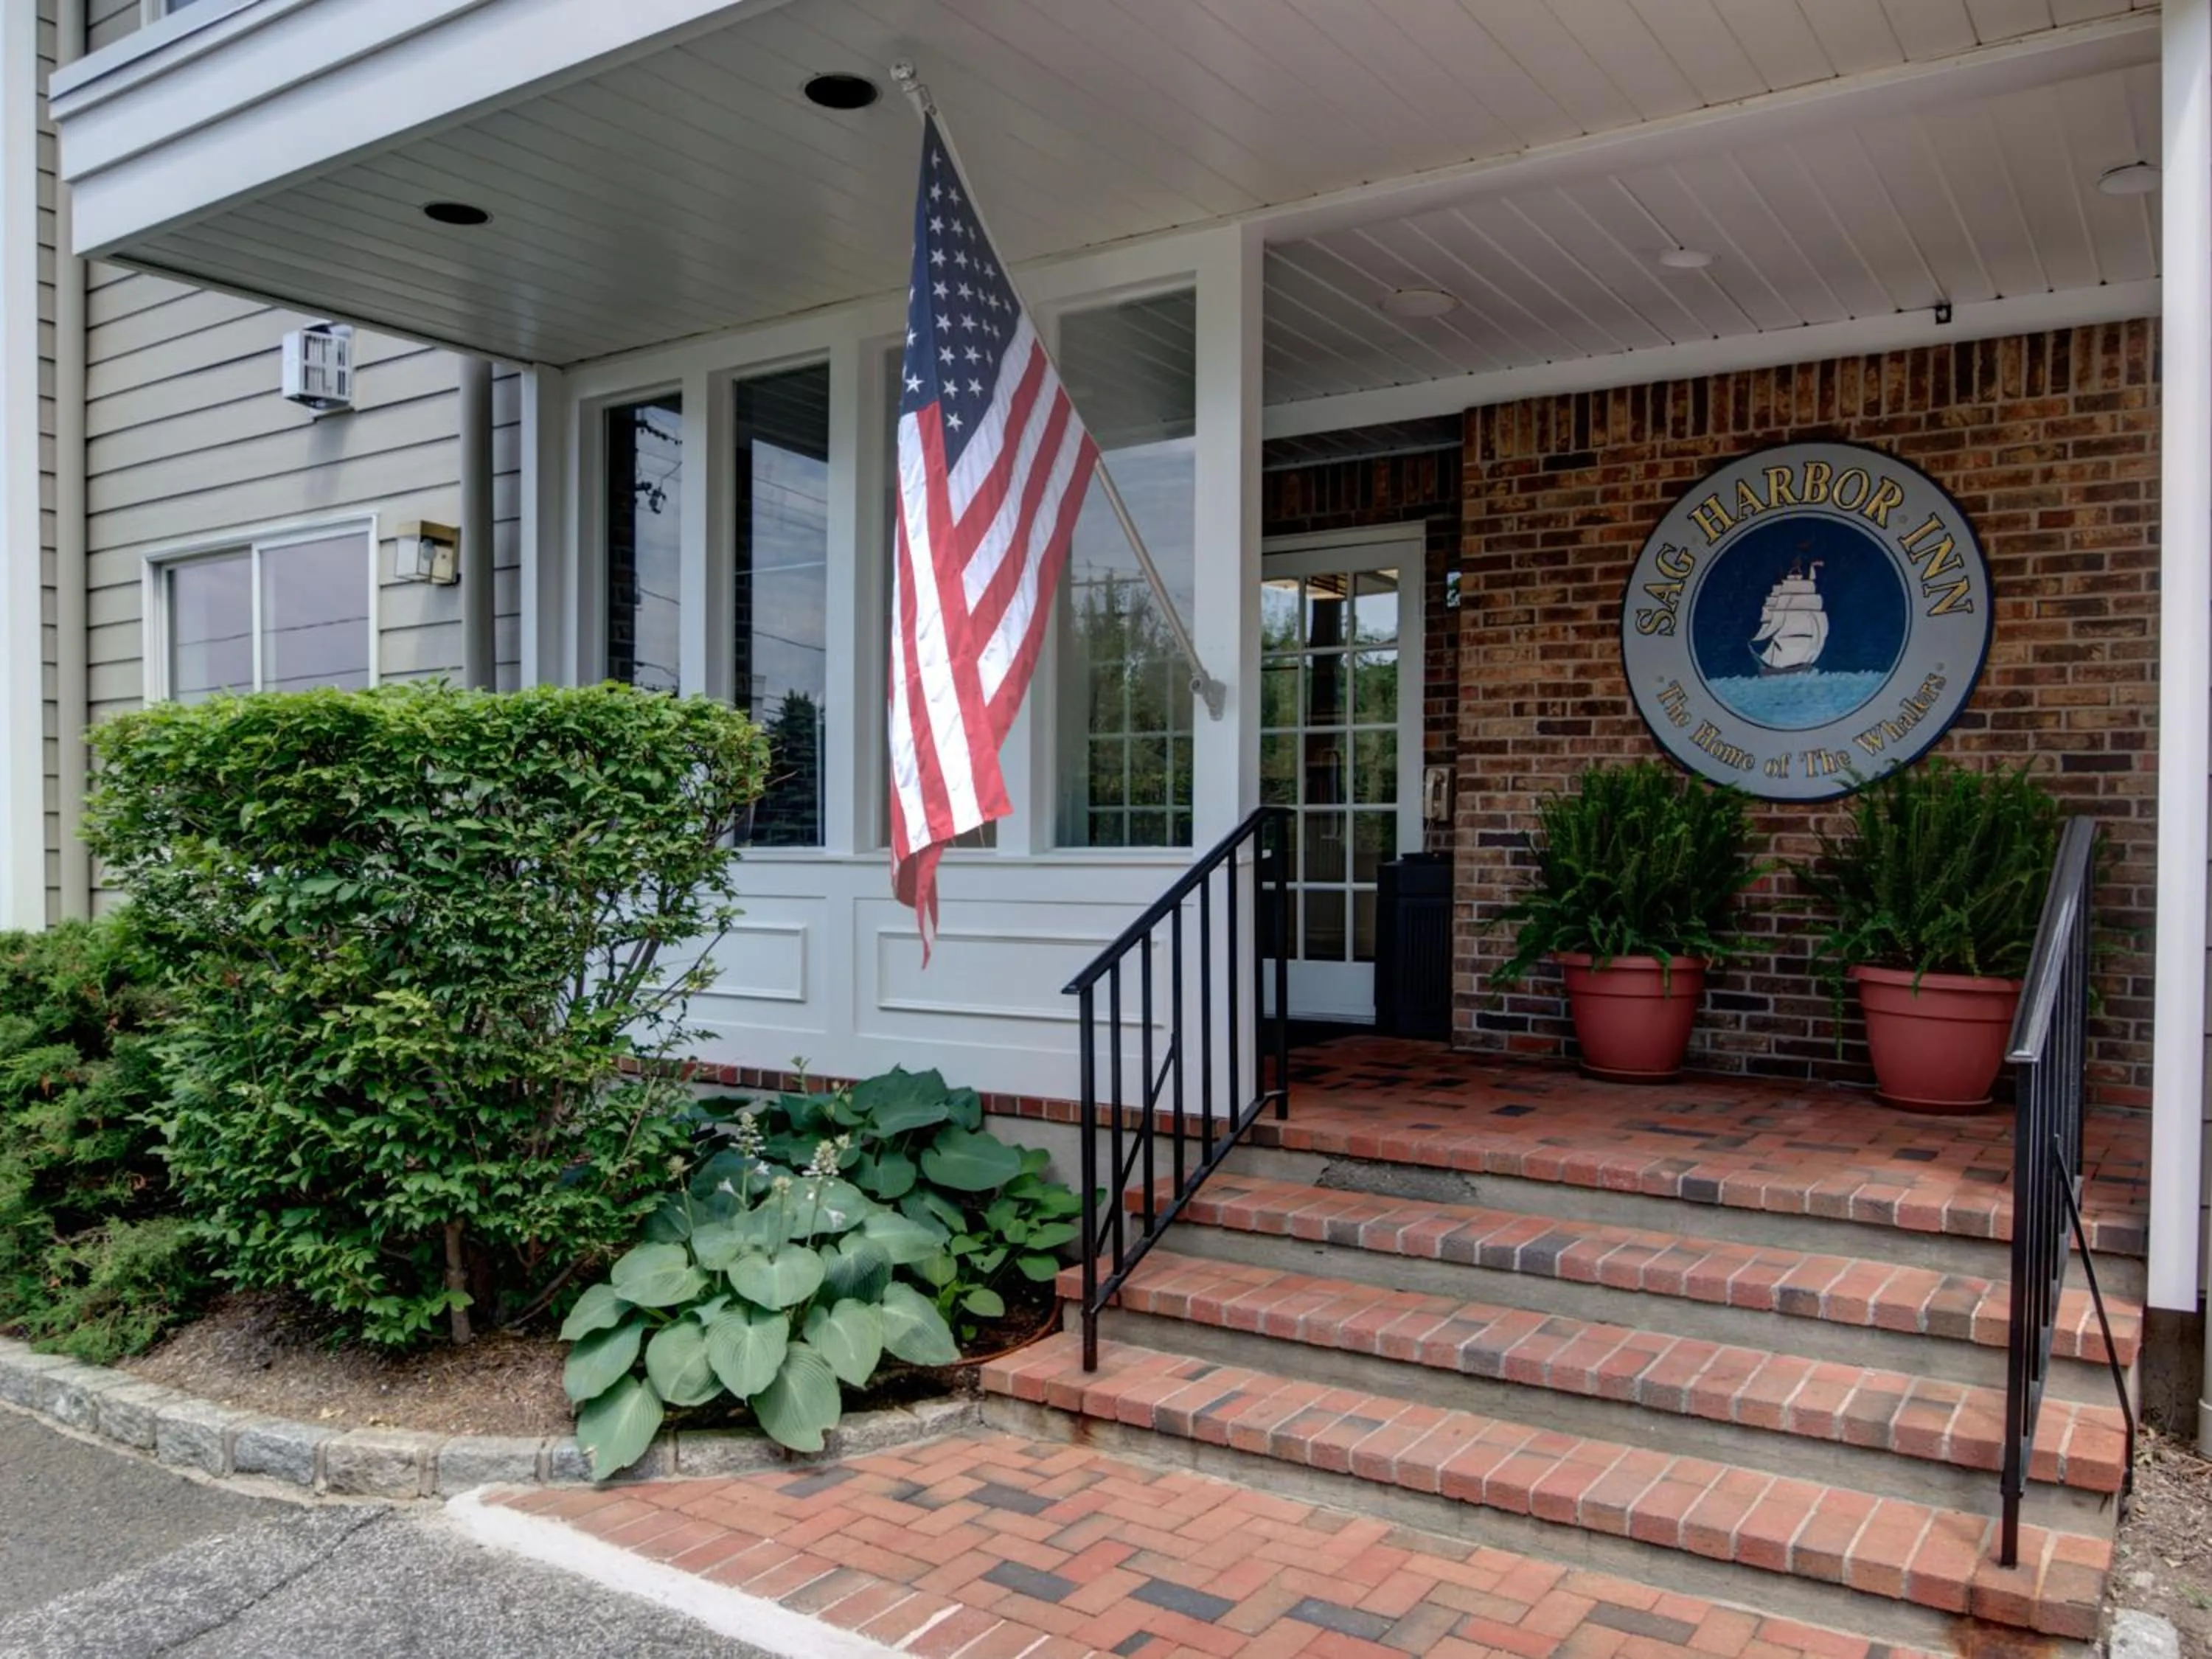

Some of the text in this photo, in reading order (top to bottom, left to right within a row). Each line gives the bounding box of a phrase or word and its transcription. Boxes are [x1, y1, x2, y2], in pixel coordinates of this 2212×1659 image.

[1636, 461, 1974, 636] SAG HARBOR INN
[1656, 679, 1693, 728] The
[1688, 720, 1756, 772] Home
[1764, 751, 1792, 778] of
[1798, 748, 1851, 778] The
